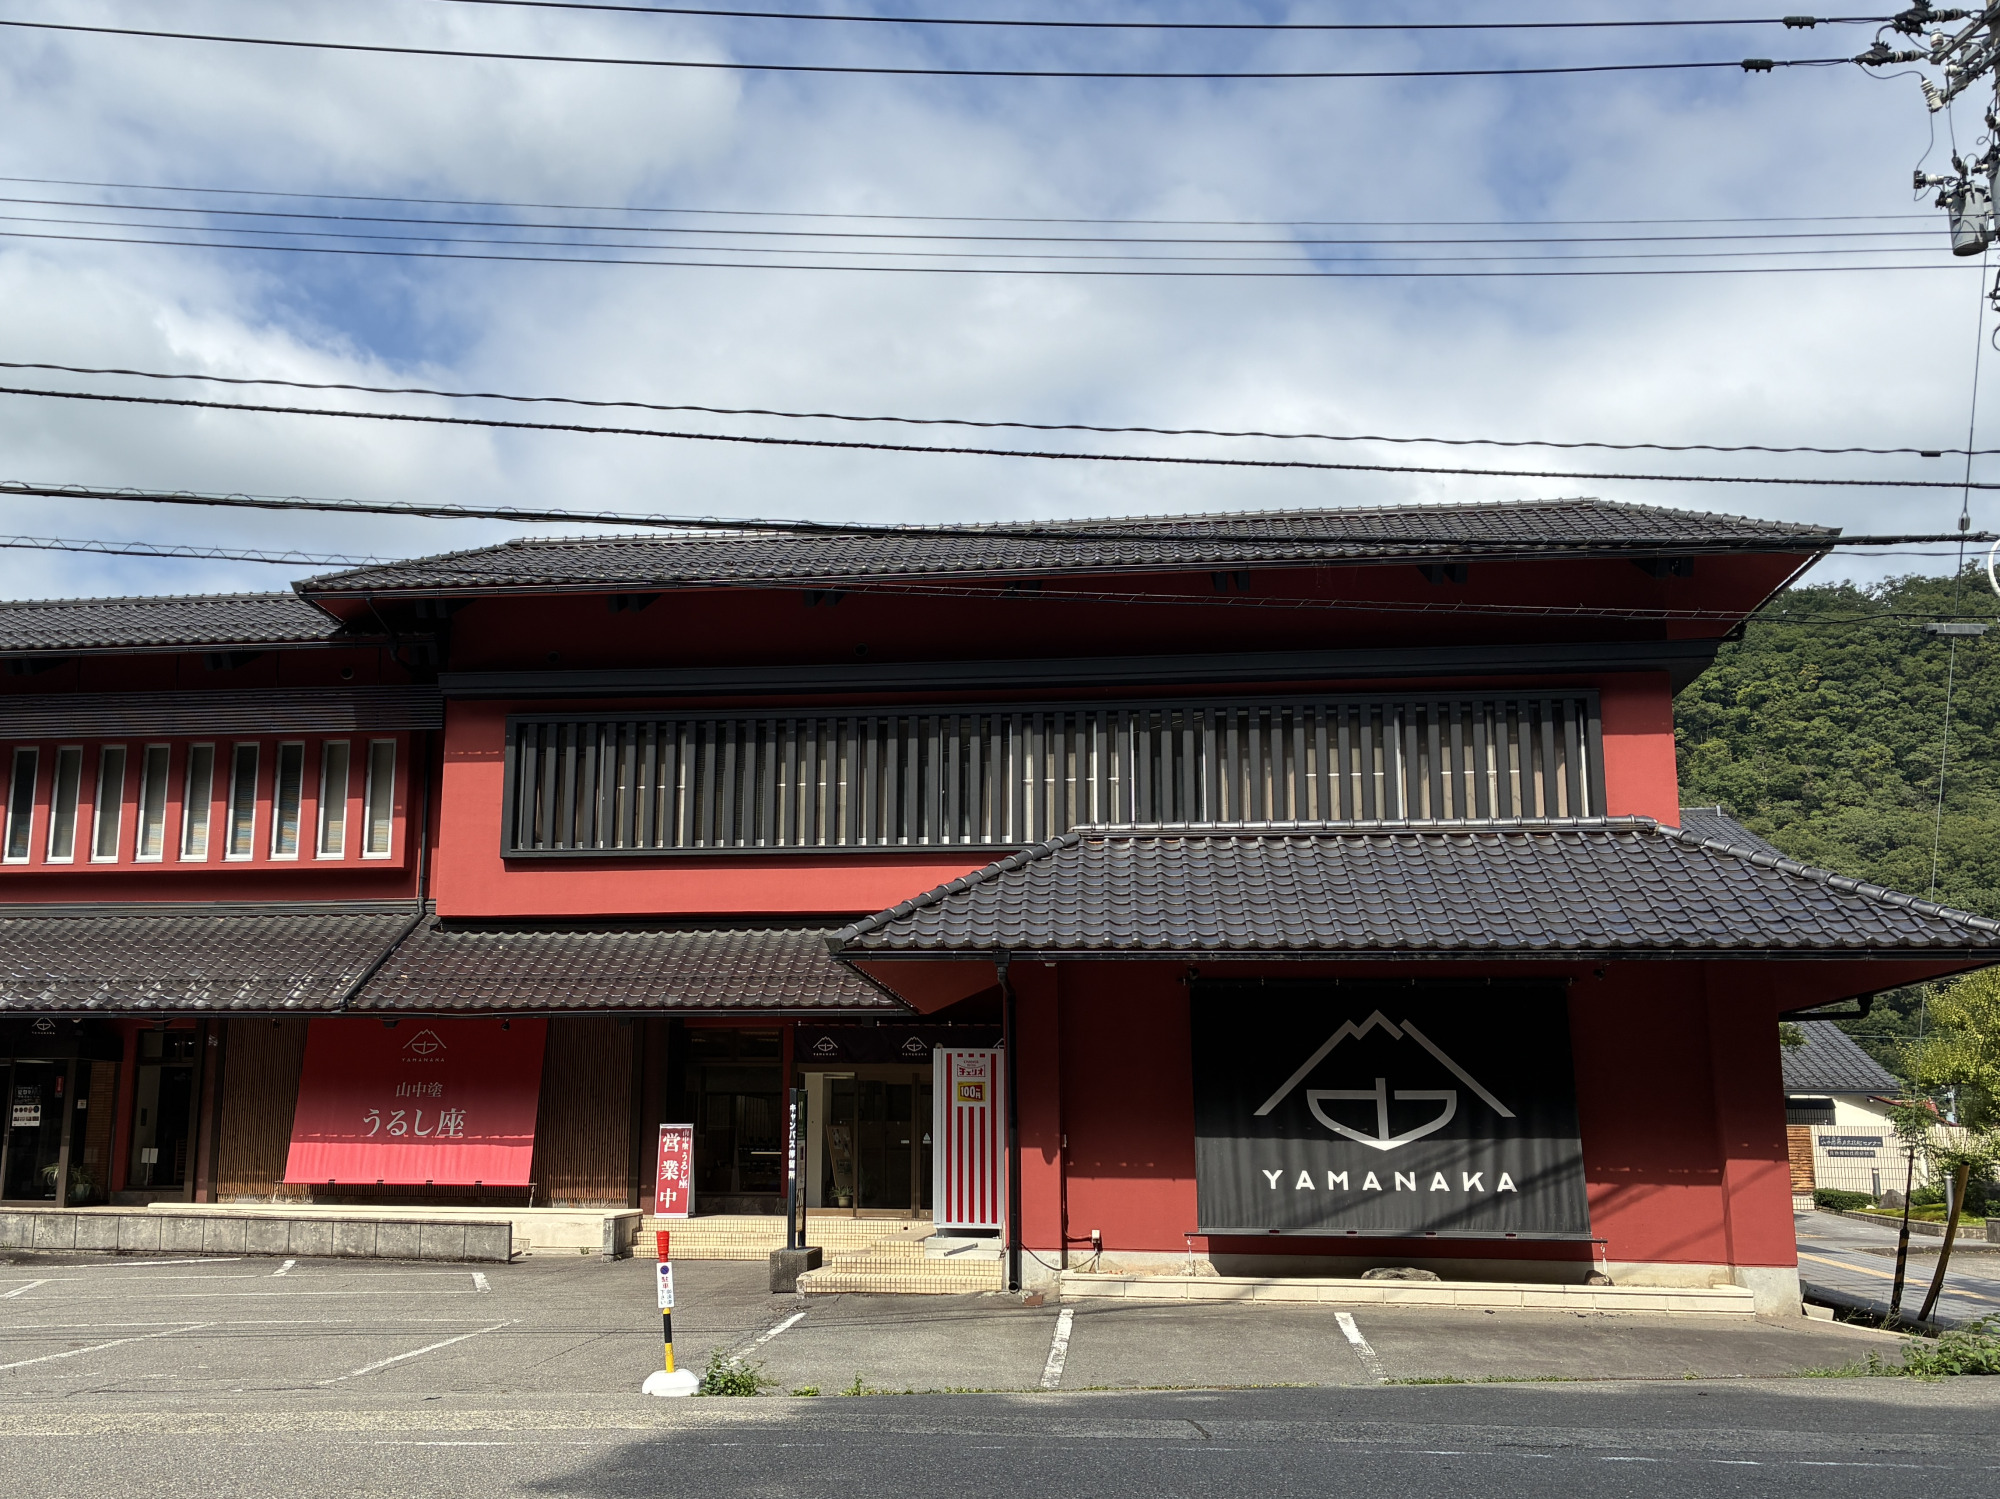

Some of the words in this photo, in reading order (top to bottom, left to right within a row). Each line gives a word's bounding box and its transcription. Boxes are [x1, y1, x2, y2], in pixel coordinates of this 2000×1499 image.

[959, 1067, 983, 1075] チェリオ
[396, 1082, 443, 1097] 山中塗
[363, 1108, 467, 1137] うるし座
[659, 1132, 680, 1209] 営業中
[1262, 1169, 1518, 1192] YAMANAKA
